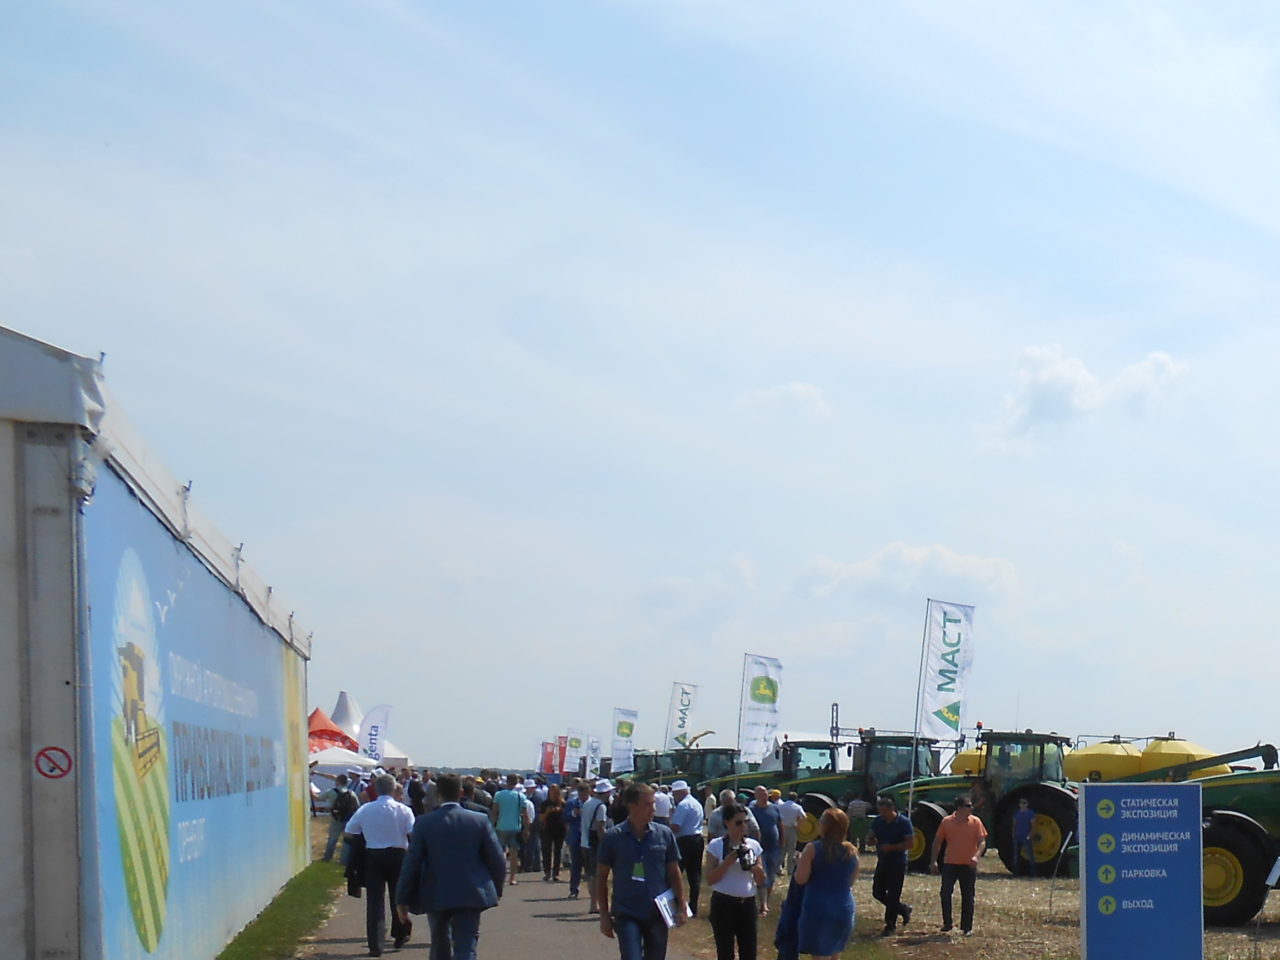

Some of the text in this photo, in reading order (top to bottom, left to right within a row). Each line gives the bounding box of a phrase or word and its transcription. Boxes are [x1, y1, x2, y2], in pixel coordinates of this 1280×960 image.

[1121, 798, 1178, 808] СТАТИЧЕСКАЯ
[1121, 810, 1178, 819] ЭКСПОЗИЦИЯ
[1121, 831, 1190, 842] ДИНАМИЧЕСКАЯ
[1121, 843, 1178, 853] ЭКСПОЗИЦИЯ
[1121, 869, 1167, 879] ПАРКОВКА
[1122, 899, 1154, 909] ВЫХОД
